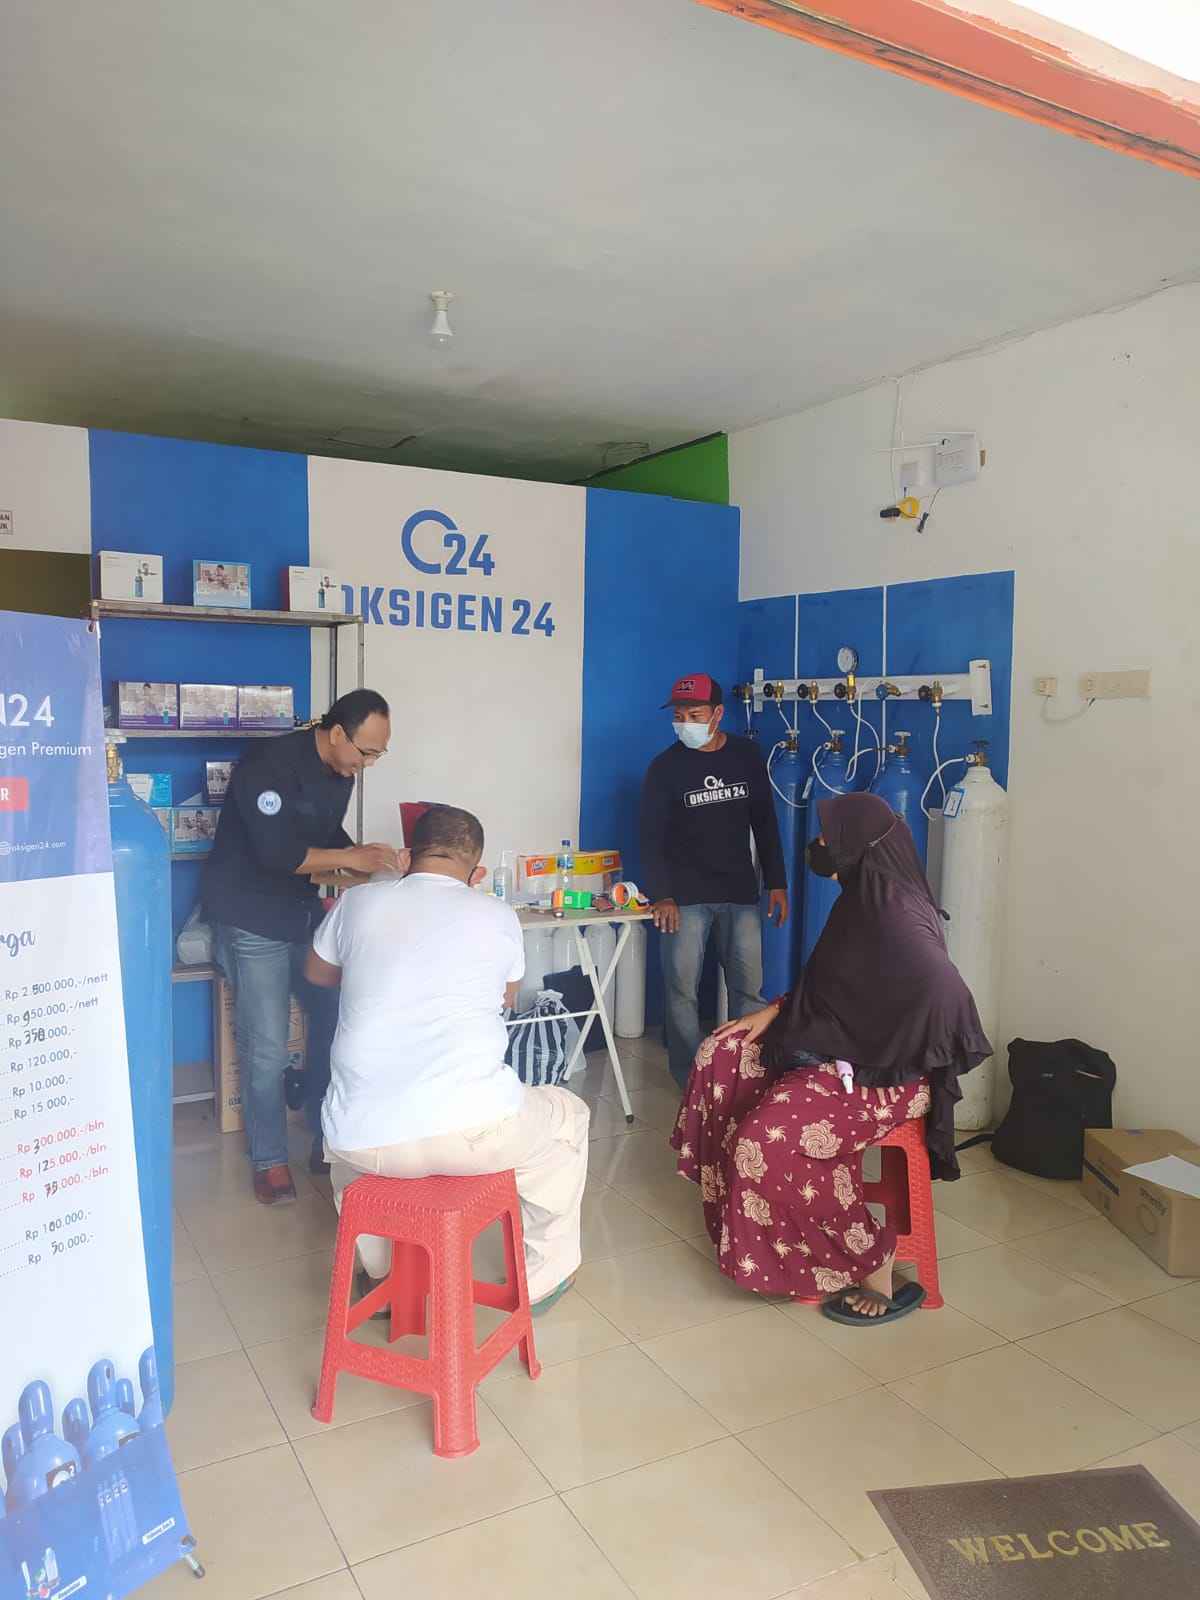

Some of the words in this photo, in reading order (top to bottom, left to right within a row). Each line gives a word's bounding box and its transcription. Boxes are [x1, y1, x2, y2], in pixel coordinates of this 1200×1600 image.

[511, 599, 555, 637] 24
[31, 741, 92, 756] Premium
[690, 788, 732, 805] OKSIGEN
[732, 785, 746, 797] 24
[5, 990, 18, 1001] Rp
[7, 1014, 20, 1026] Rp
[8, 1038, 22, 1049] Rp
[10, 1062, 24, 1073] Rp
[12, 1087, 26, 1098] Rp
[14, 1109, 28, 1120] Rp
[17, 1144, 31, 1154] Rp
[19, 1168, 33, 1179] Rp
[22, 1192, 36, 1203] Rp
[25, 1230, 39, 1241] Rp
[28, 1254, 42, 1265] Rp
[947, 1521, 1170, 1565] WELCOME
